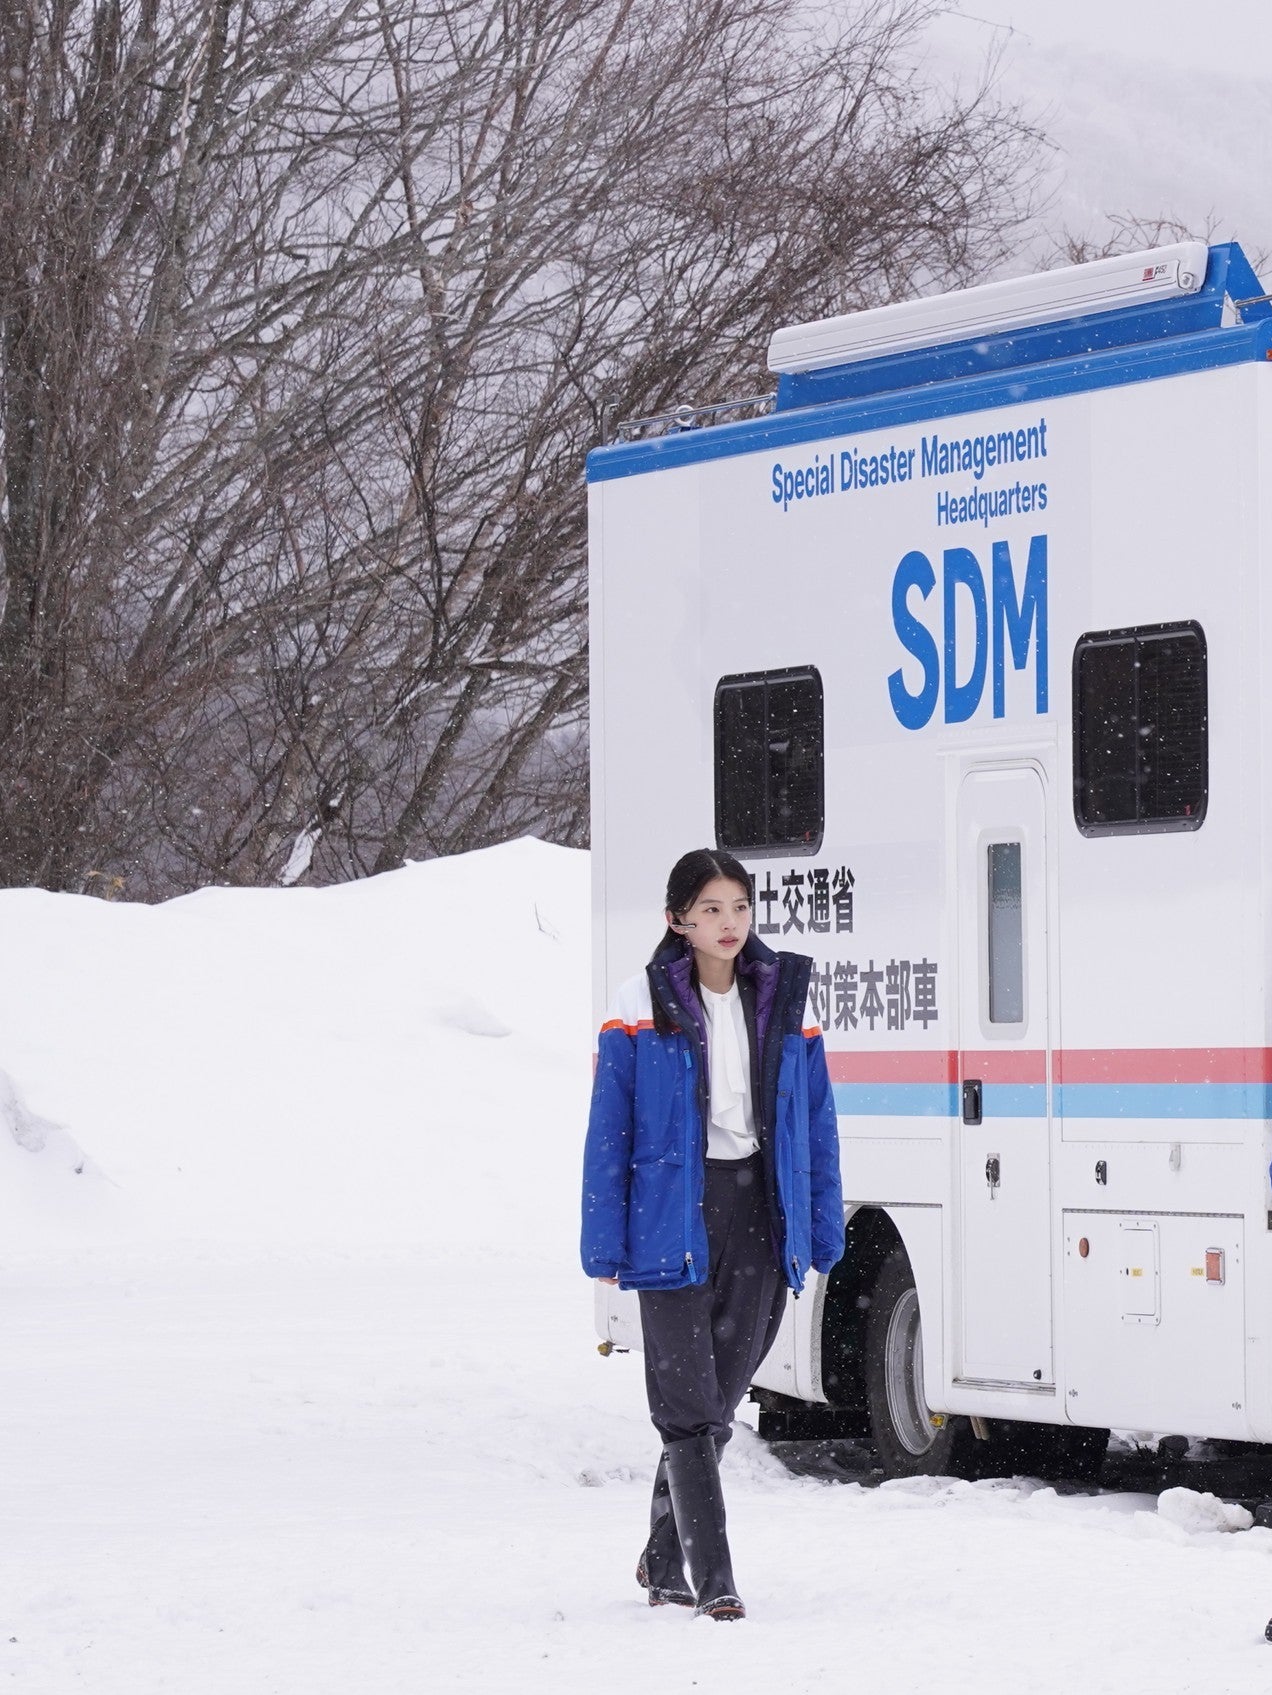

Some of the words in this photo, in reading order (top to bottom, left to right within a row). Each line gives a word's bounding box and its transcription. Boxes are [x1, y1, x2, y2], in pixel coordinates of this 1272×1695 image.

[771, 453, 835, 513] Special
[840, 446, 916, 492] Disaster
[921, 418, 1048, 480] Management
[937, 481, 1048, 528] Headquarters
[887, 534, 1049, 731] SDM
[749, 866, 856, 935] 土交通省
